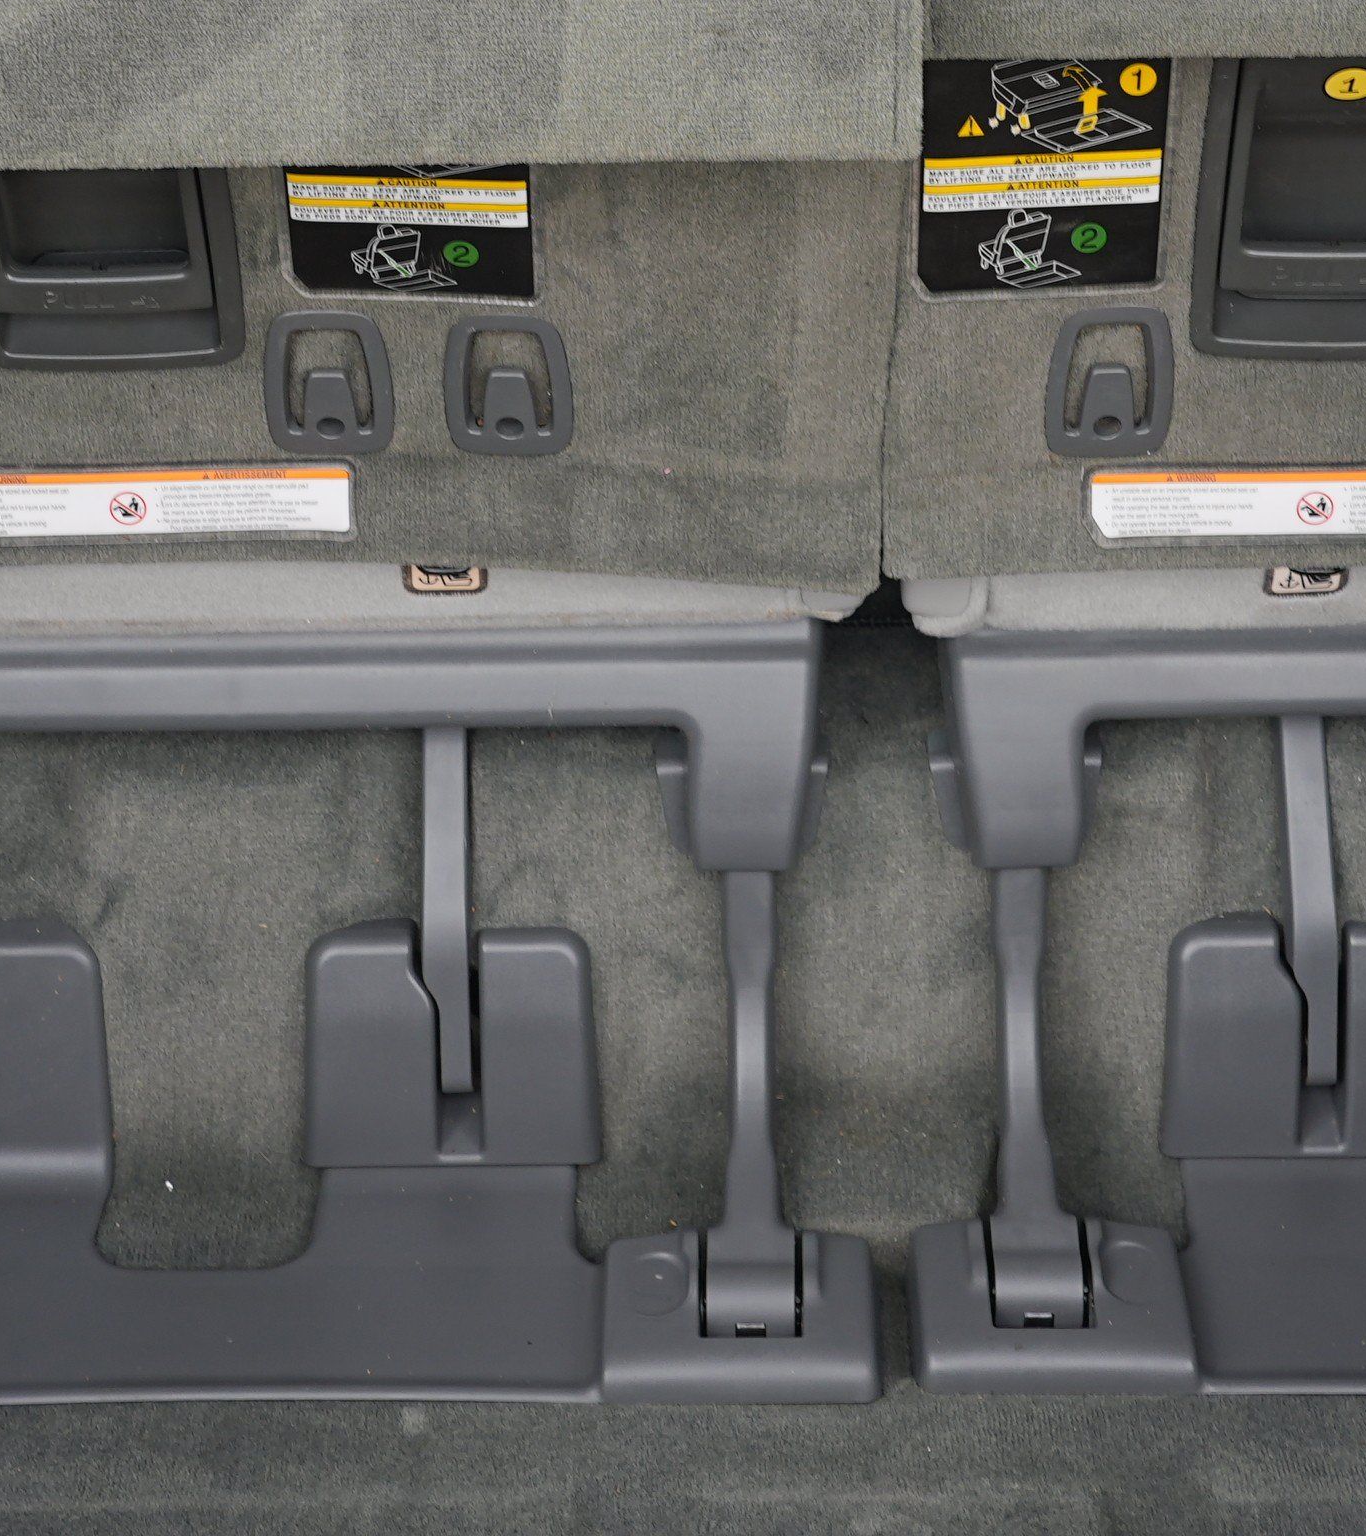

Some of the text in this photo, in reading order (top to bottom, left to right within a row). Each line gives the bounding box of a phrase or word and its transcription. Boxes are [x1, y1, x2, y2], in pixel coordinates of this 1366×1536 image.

[1133, 69, 1142, 91] 1
[1340, 77, 1359, 93] 1
[1026, 155, 1075, 164] CAUTION
[387, 178, 438, 187] CAUTION
[1018, 180, 1079, 190] ATTENTION
[384, 201, 445, 210] ATTENTION
[1081, 227, 1099, 248] 2
[453, 245, 471, 264] 2
